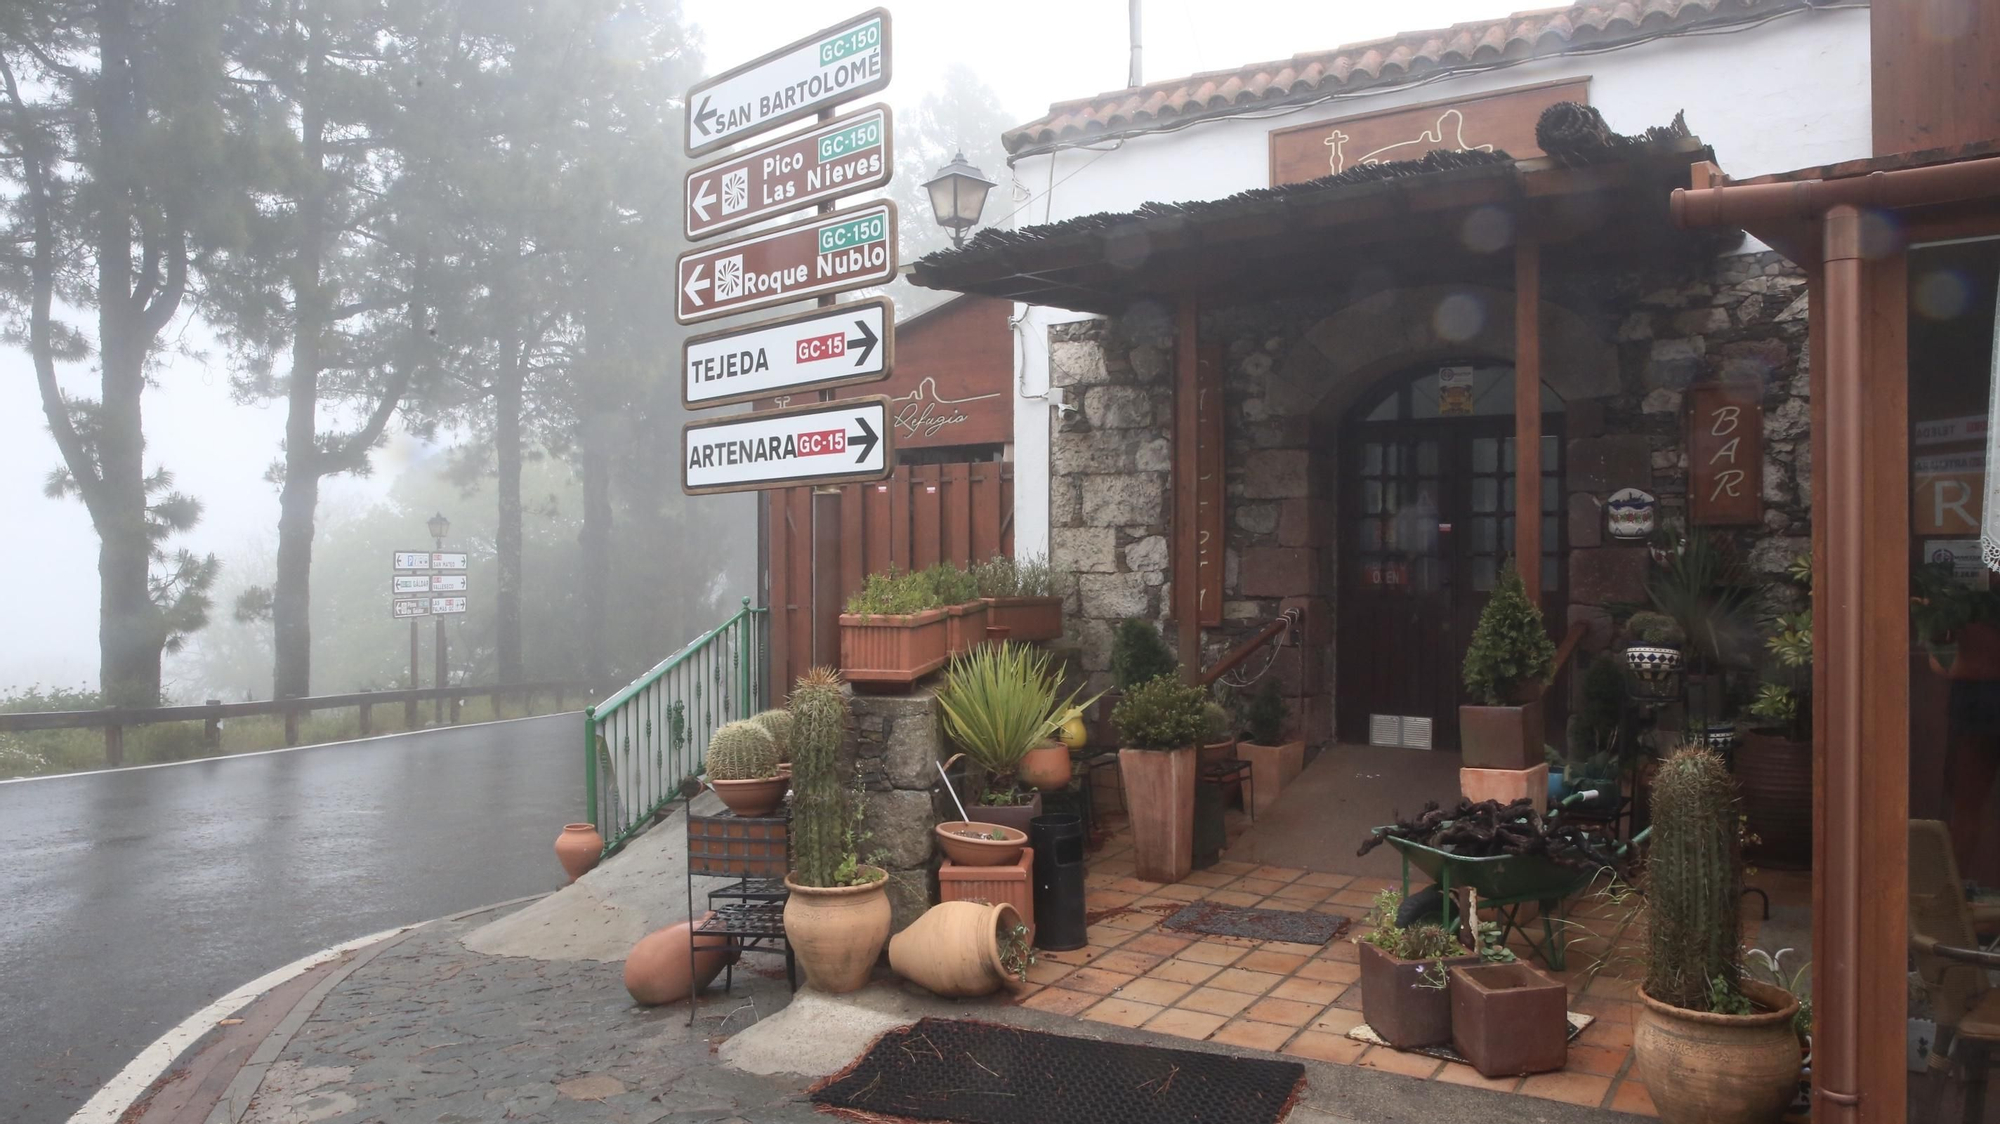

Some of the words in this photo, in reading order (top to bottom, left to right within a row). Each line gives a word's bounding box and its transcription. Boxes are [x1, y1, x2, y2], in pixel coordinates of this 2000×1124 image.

[822, 27, 878, 62] GC-150
[715, 102, 751, 134] SAN
[760, 48, 880, 118] BARTOLOMÉ
[821, 124, 877, 157] GC-150
[763, 152, 804, 180] Pico
[763, 180, 796, 205] Las
[807, 153, 881, 192] Nieves
[822, 219, 881, 249] GC-150
[744, 264, 808, 296] Roque
[816, 244, 885, 279] Nublo
[692, 347, 769, 384] TEJEDA
[798, 335, 843, 360] GC-15
[894, 402, 968, 439] Refugio
[689, 434, 798, 469] ARTENARA
[799, 432, 844, 454] GC-15
[1709, 406, 1744, 502] BAR
[1934, 480, 1979, 527] R
[1372, 570, 1399, 584] OEN
